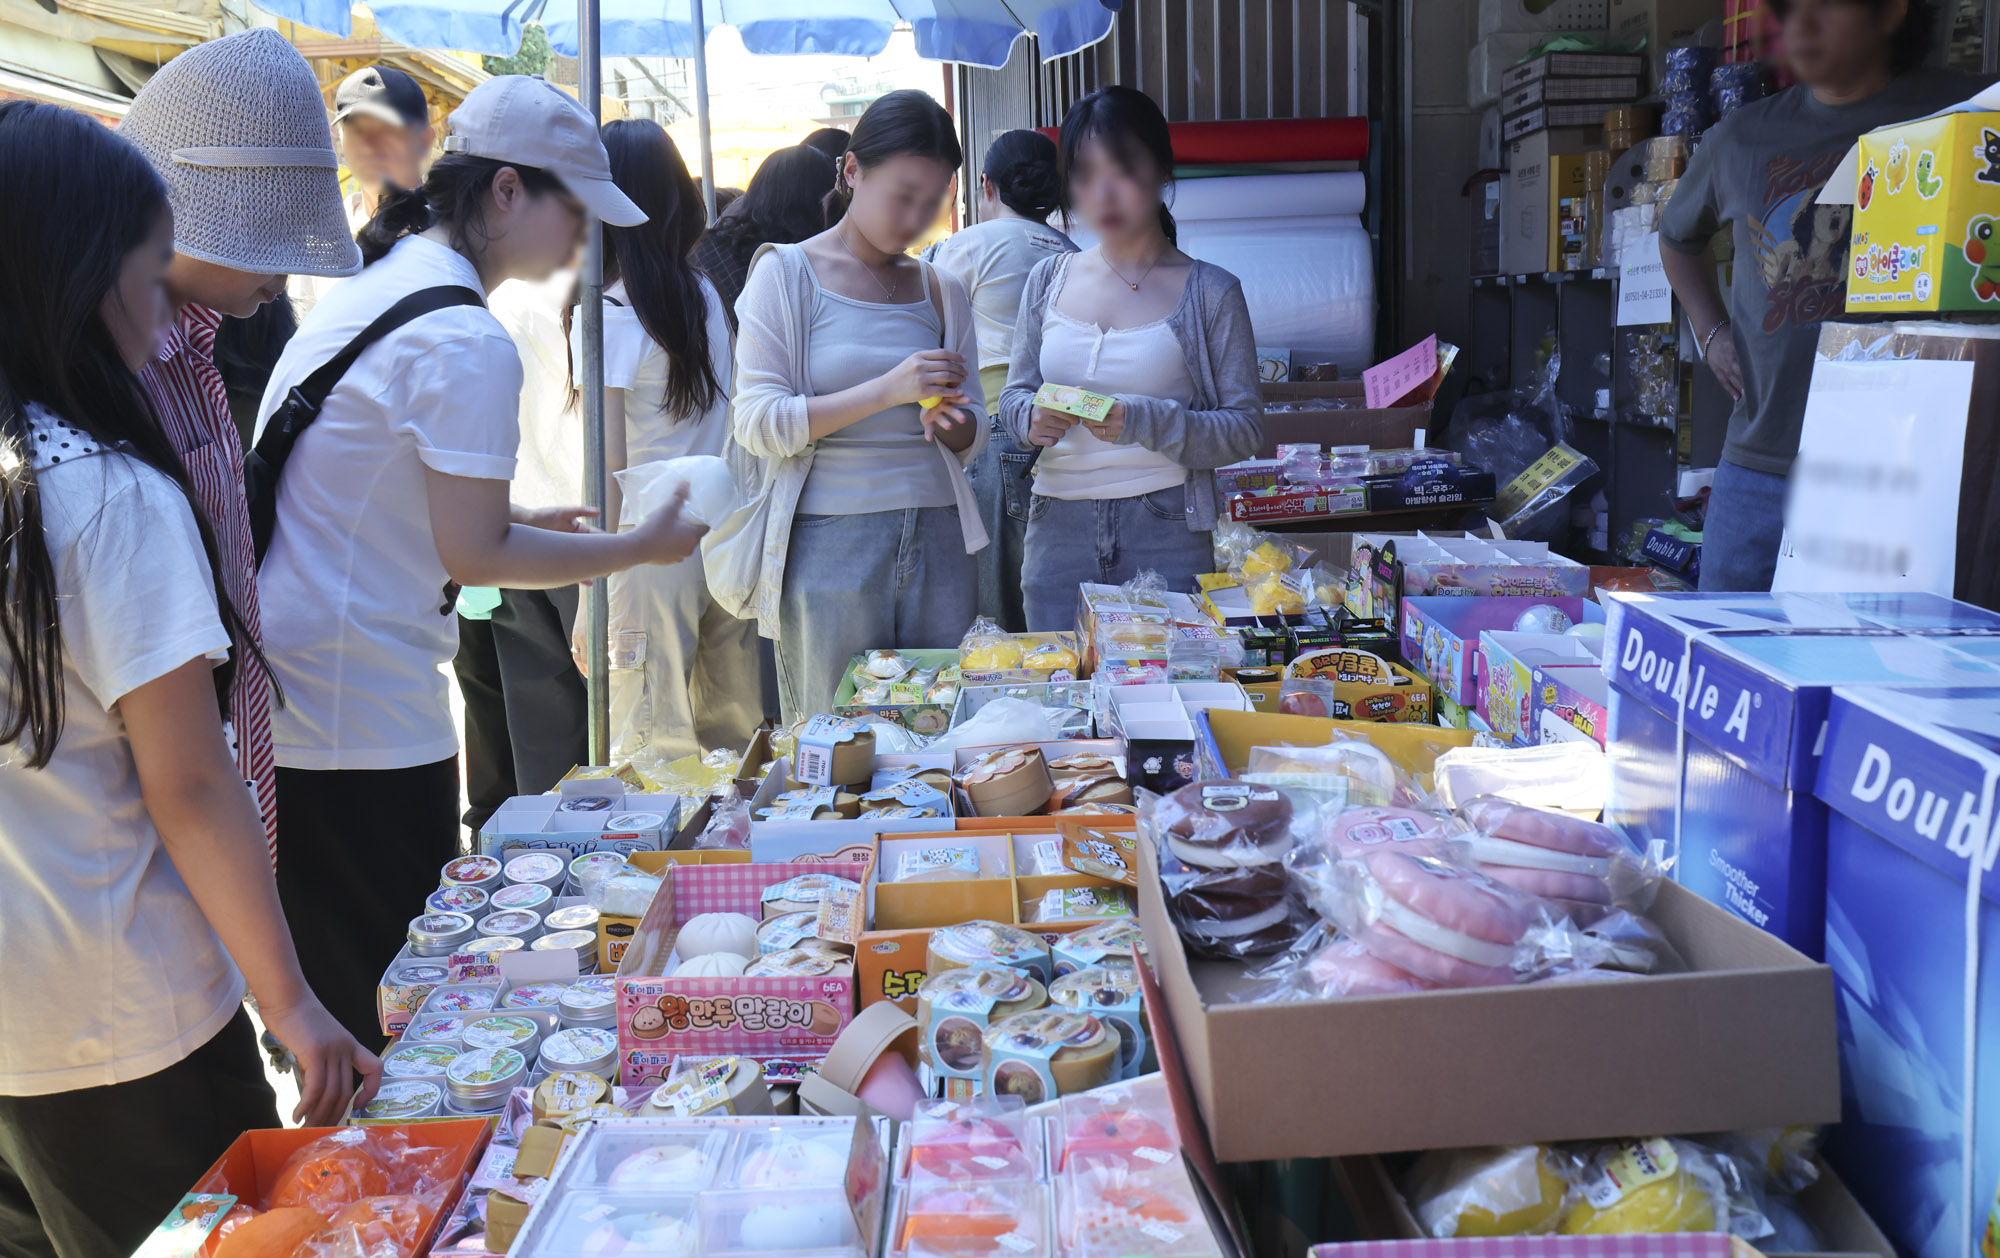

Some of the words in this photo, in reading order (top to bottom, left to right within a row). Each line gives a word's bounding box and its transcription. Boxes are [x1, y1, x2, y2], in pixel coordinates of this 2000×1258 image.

[1869, 244, 1922, 280] 아이클레이
[1414, 486, 1425, 495] 빅
[1438, 492, 1463, 503] 슬라임
[1646, 535, 1675, 558] Double
[1673, 547, 1684, 561] A
[1501, 576, 1543, 589] 아이스크림
[1437, 587, 1475, 597] Dorothy
[1311, 654, 1341, 670] 슬라임
[1621, 627, 1720, 720] Double
[1724, 688, 1752, 743] A
[1410, 693, 1427, 702] 6EA
[852, 853, 870, 861] 명장
[1709, 849, 1760, 897] Smoother
[1725, 882, 1769, 928] Thicker
[627, 986, 663, 996] 토이파크
[822, 983, 843, 992] 6EA
[657, 995, 735, 1029] 왕만두
[735, 998, 812, 1031] 말랑이
[631, 1055, 668, 1065] 토이파크
